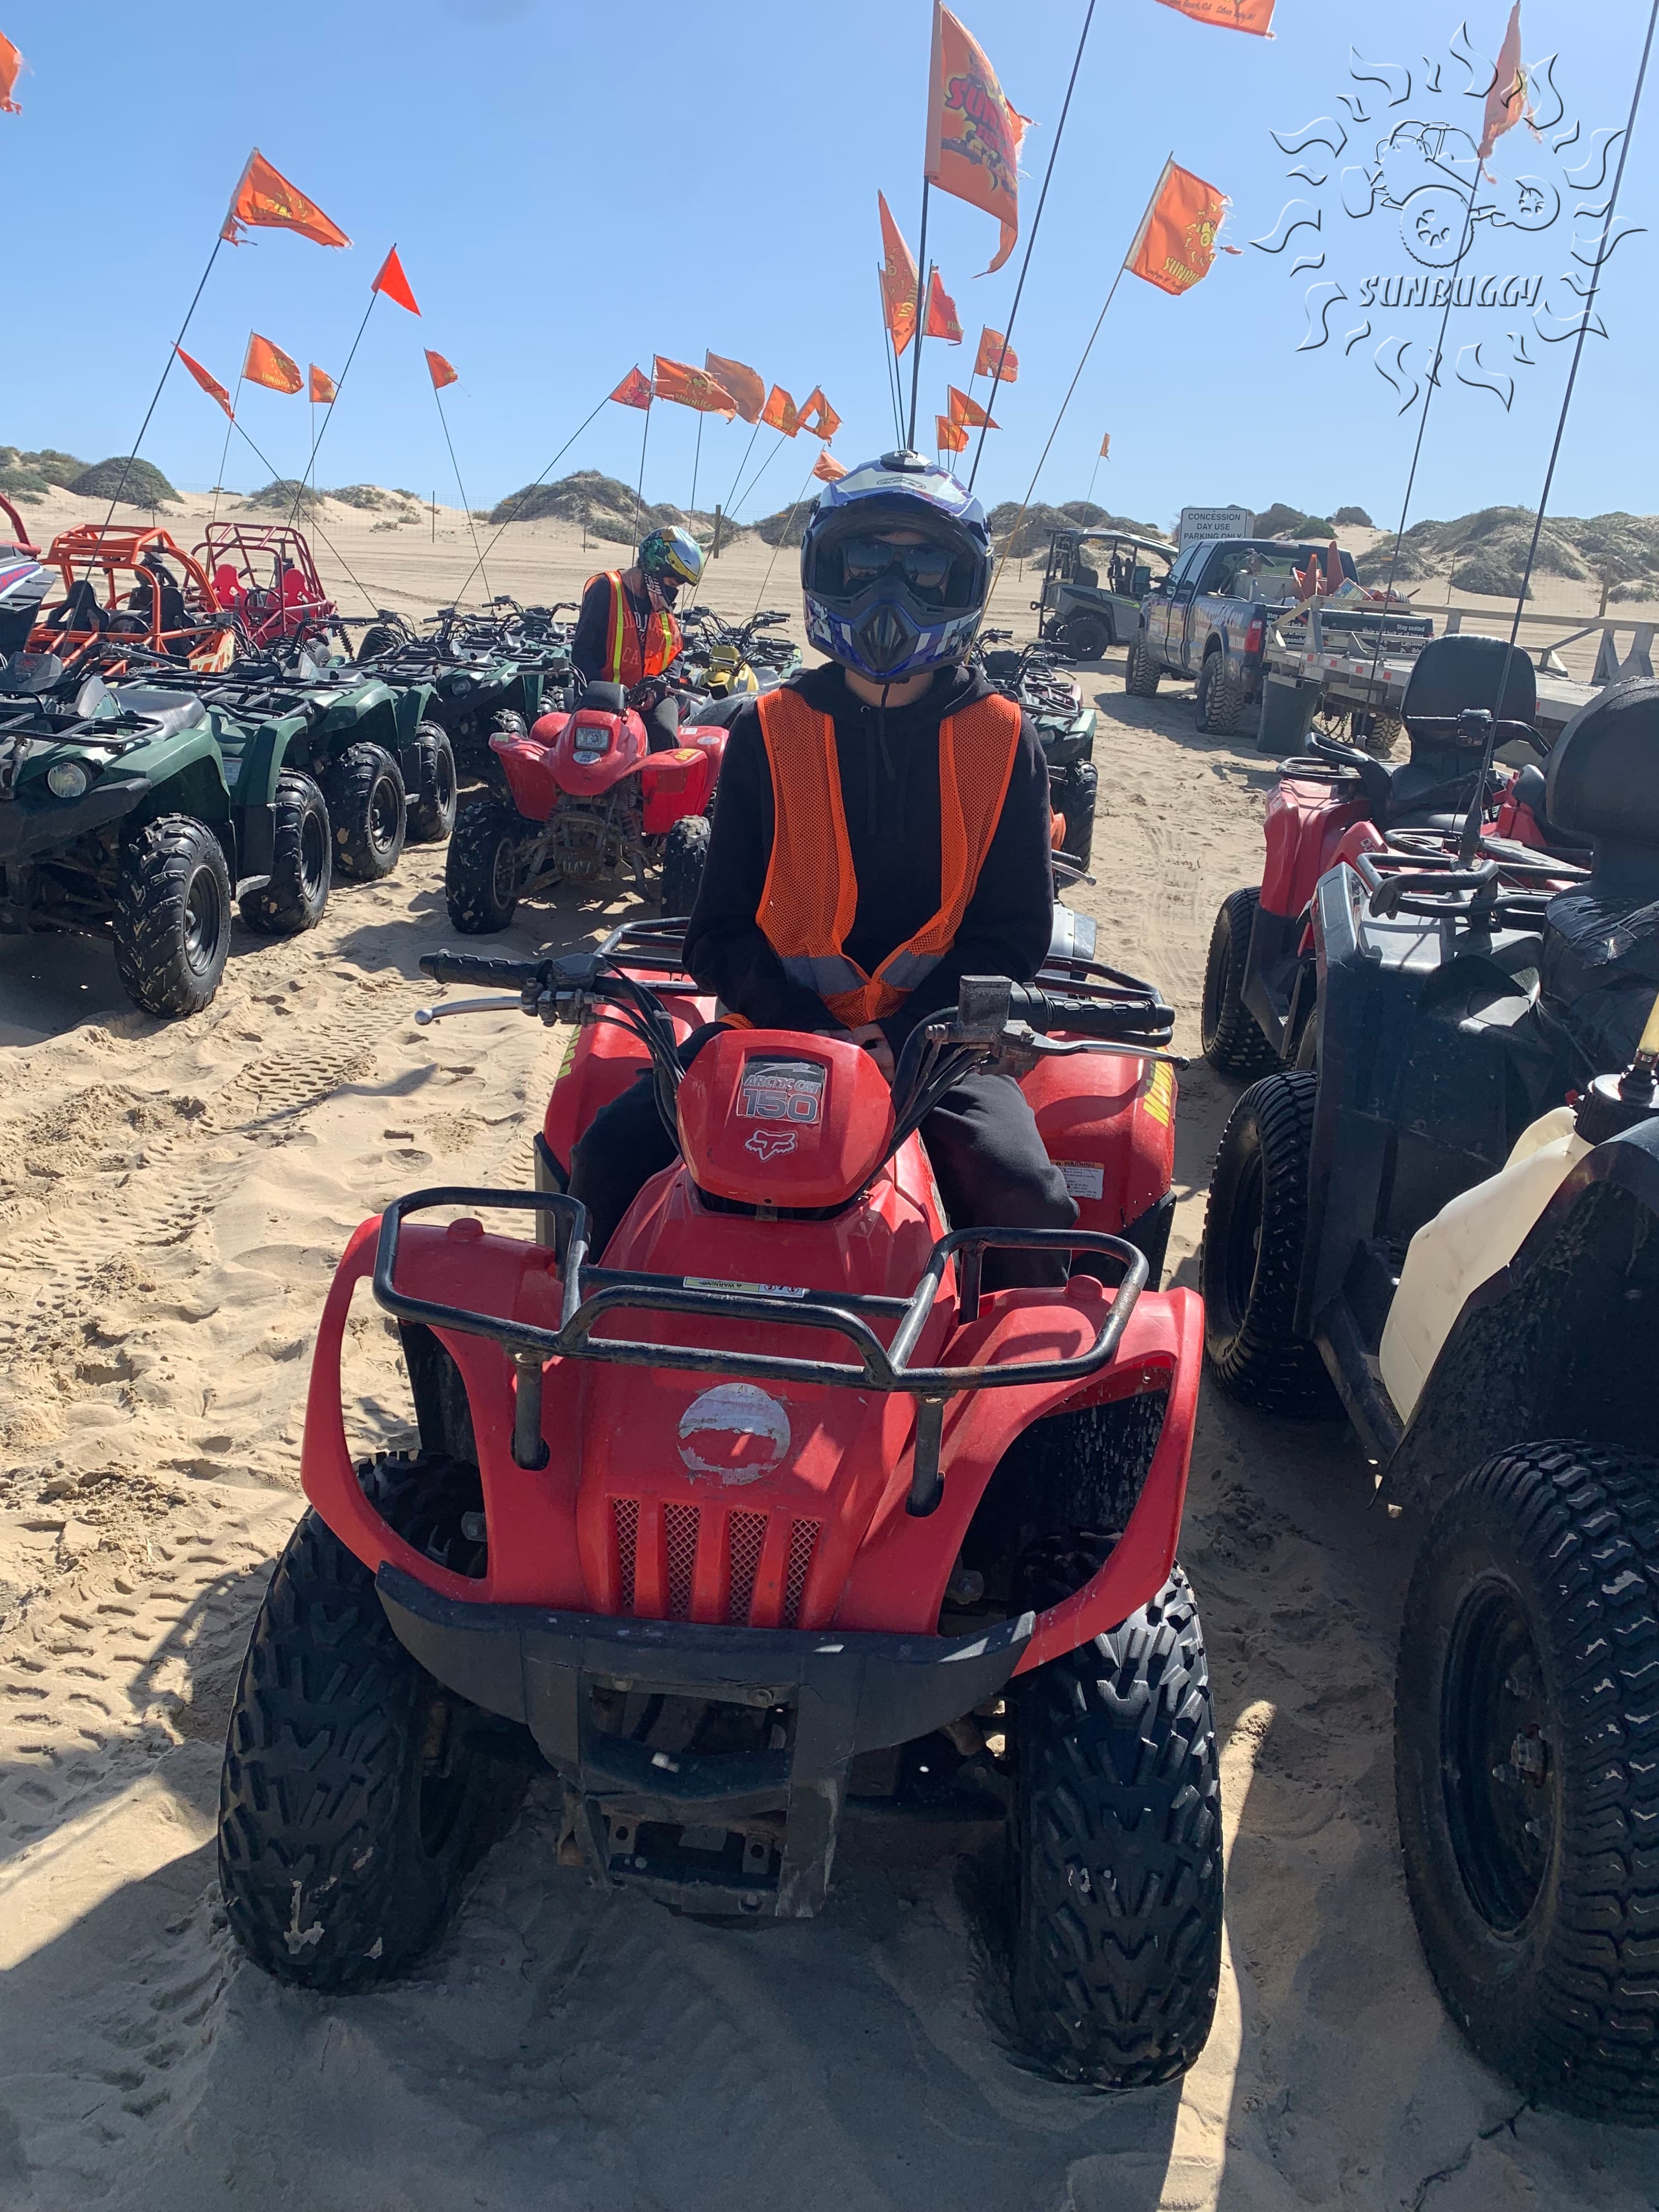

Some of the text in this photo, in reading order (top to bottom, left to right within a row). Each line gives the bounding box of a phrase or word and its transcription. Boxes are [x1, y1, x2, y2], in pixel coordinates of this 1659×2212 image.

[743, 1075, 822, 1093] ARCTIC CAT
[743, 1088, 818, 1122] 150
